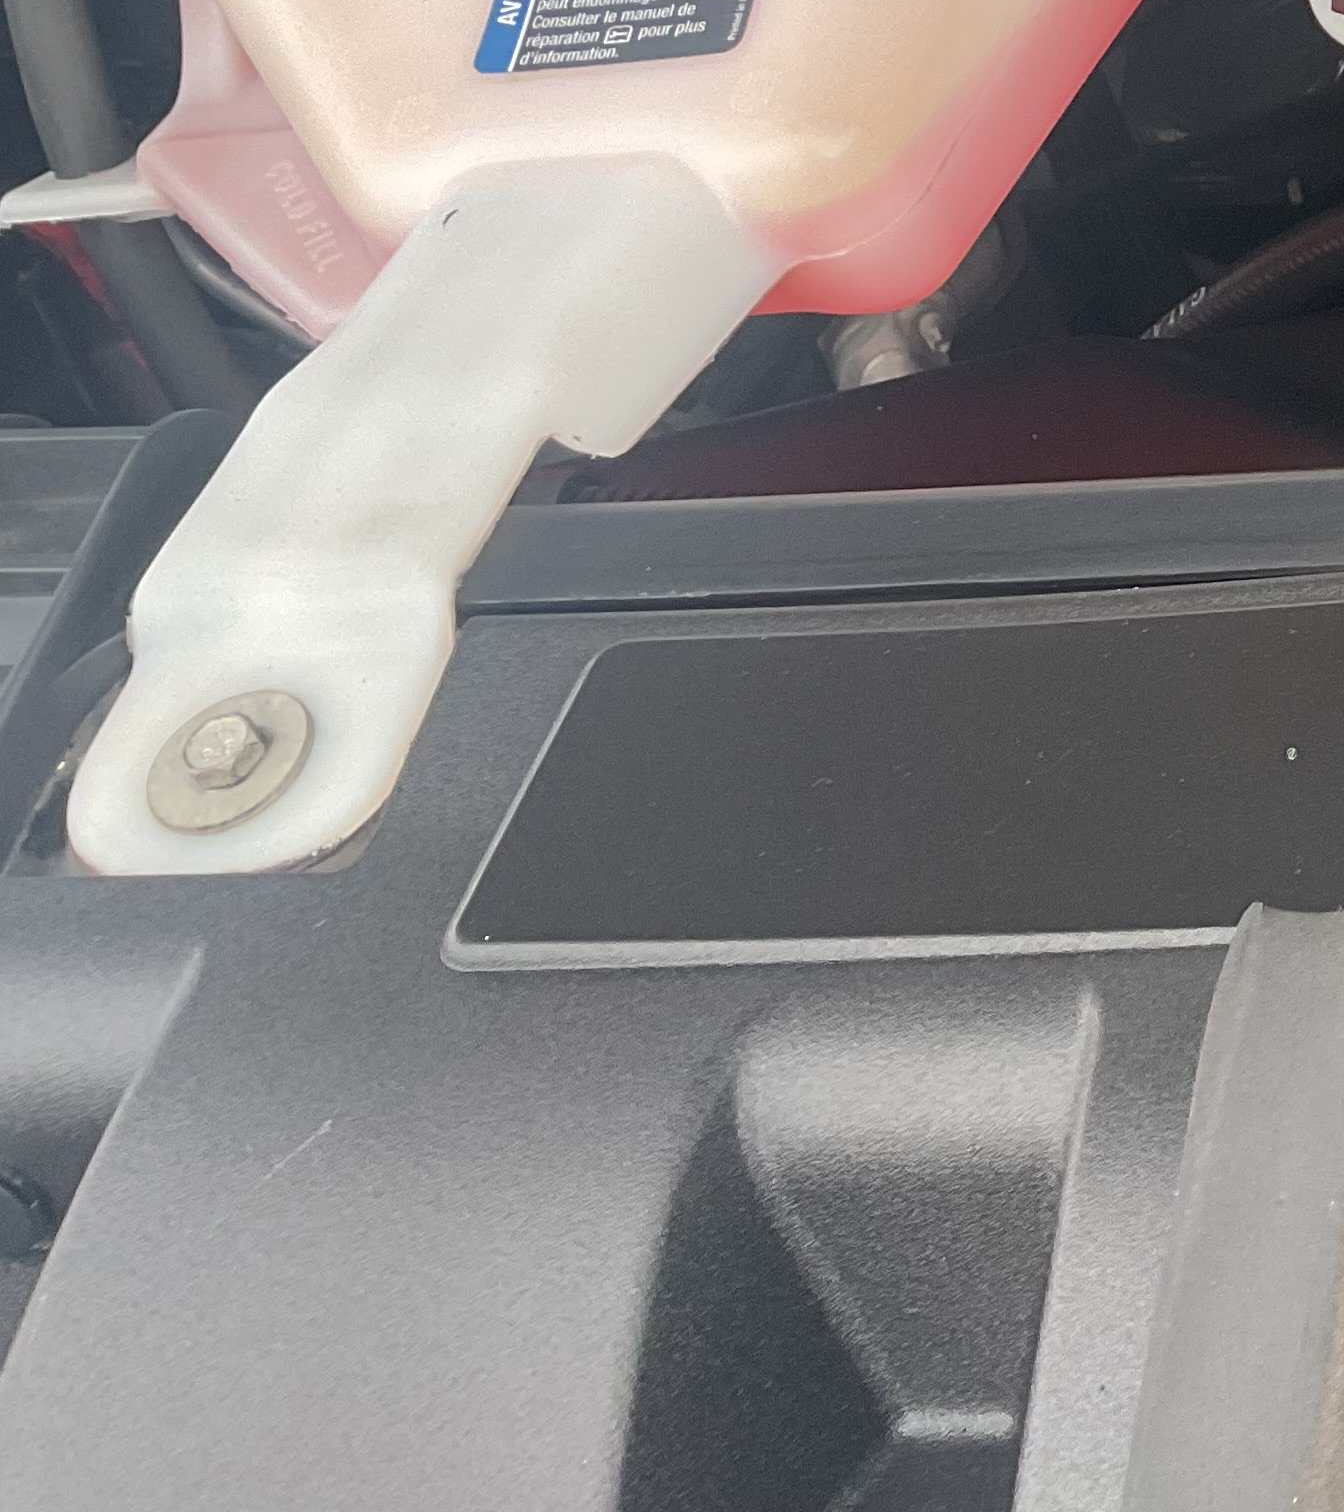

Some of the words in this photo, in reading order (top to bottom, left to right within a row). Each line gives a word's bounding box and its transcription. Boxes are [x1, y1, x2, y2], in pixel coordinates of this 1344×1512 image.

[532, 14, 599, 30] Consulter
[604, 8, 618, 23] le
[622, 5, 674, 23] manuel
[677, 1, 696, 17] de
[525, 29, 599, 48] réparation
[638, 24, 671, 41] pour
[673, 19, 706, 36] plus
[520, 47, 619, 66] d'information.
